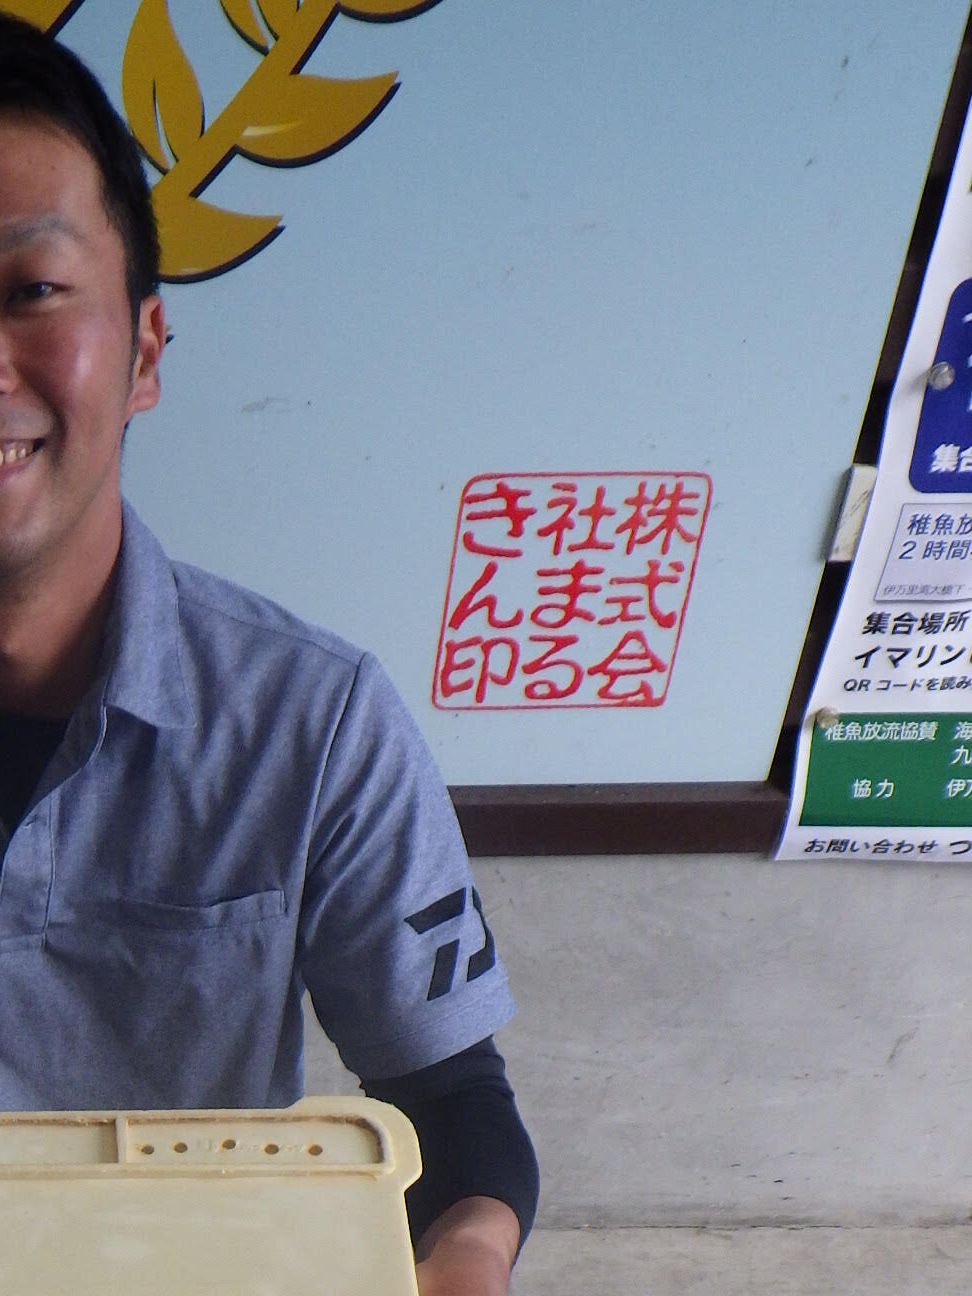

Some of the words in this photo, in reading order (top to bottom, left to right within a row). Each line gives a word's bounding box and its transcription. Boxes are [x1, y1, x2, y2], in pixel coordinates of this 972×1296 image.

[898, 540, 972, 561] 2時間
[861, 609, 972, 635] 集合場所
[854, 643, 972, 669] イマリン
[852, 778, 895, 799] 協力
[804, 838, 939, 855] お問い合わせ
